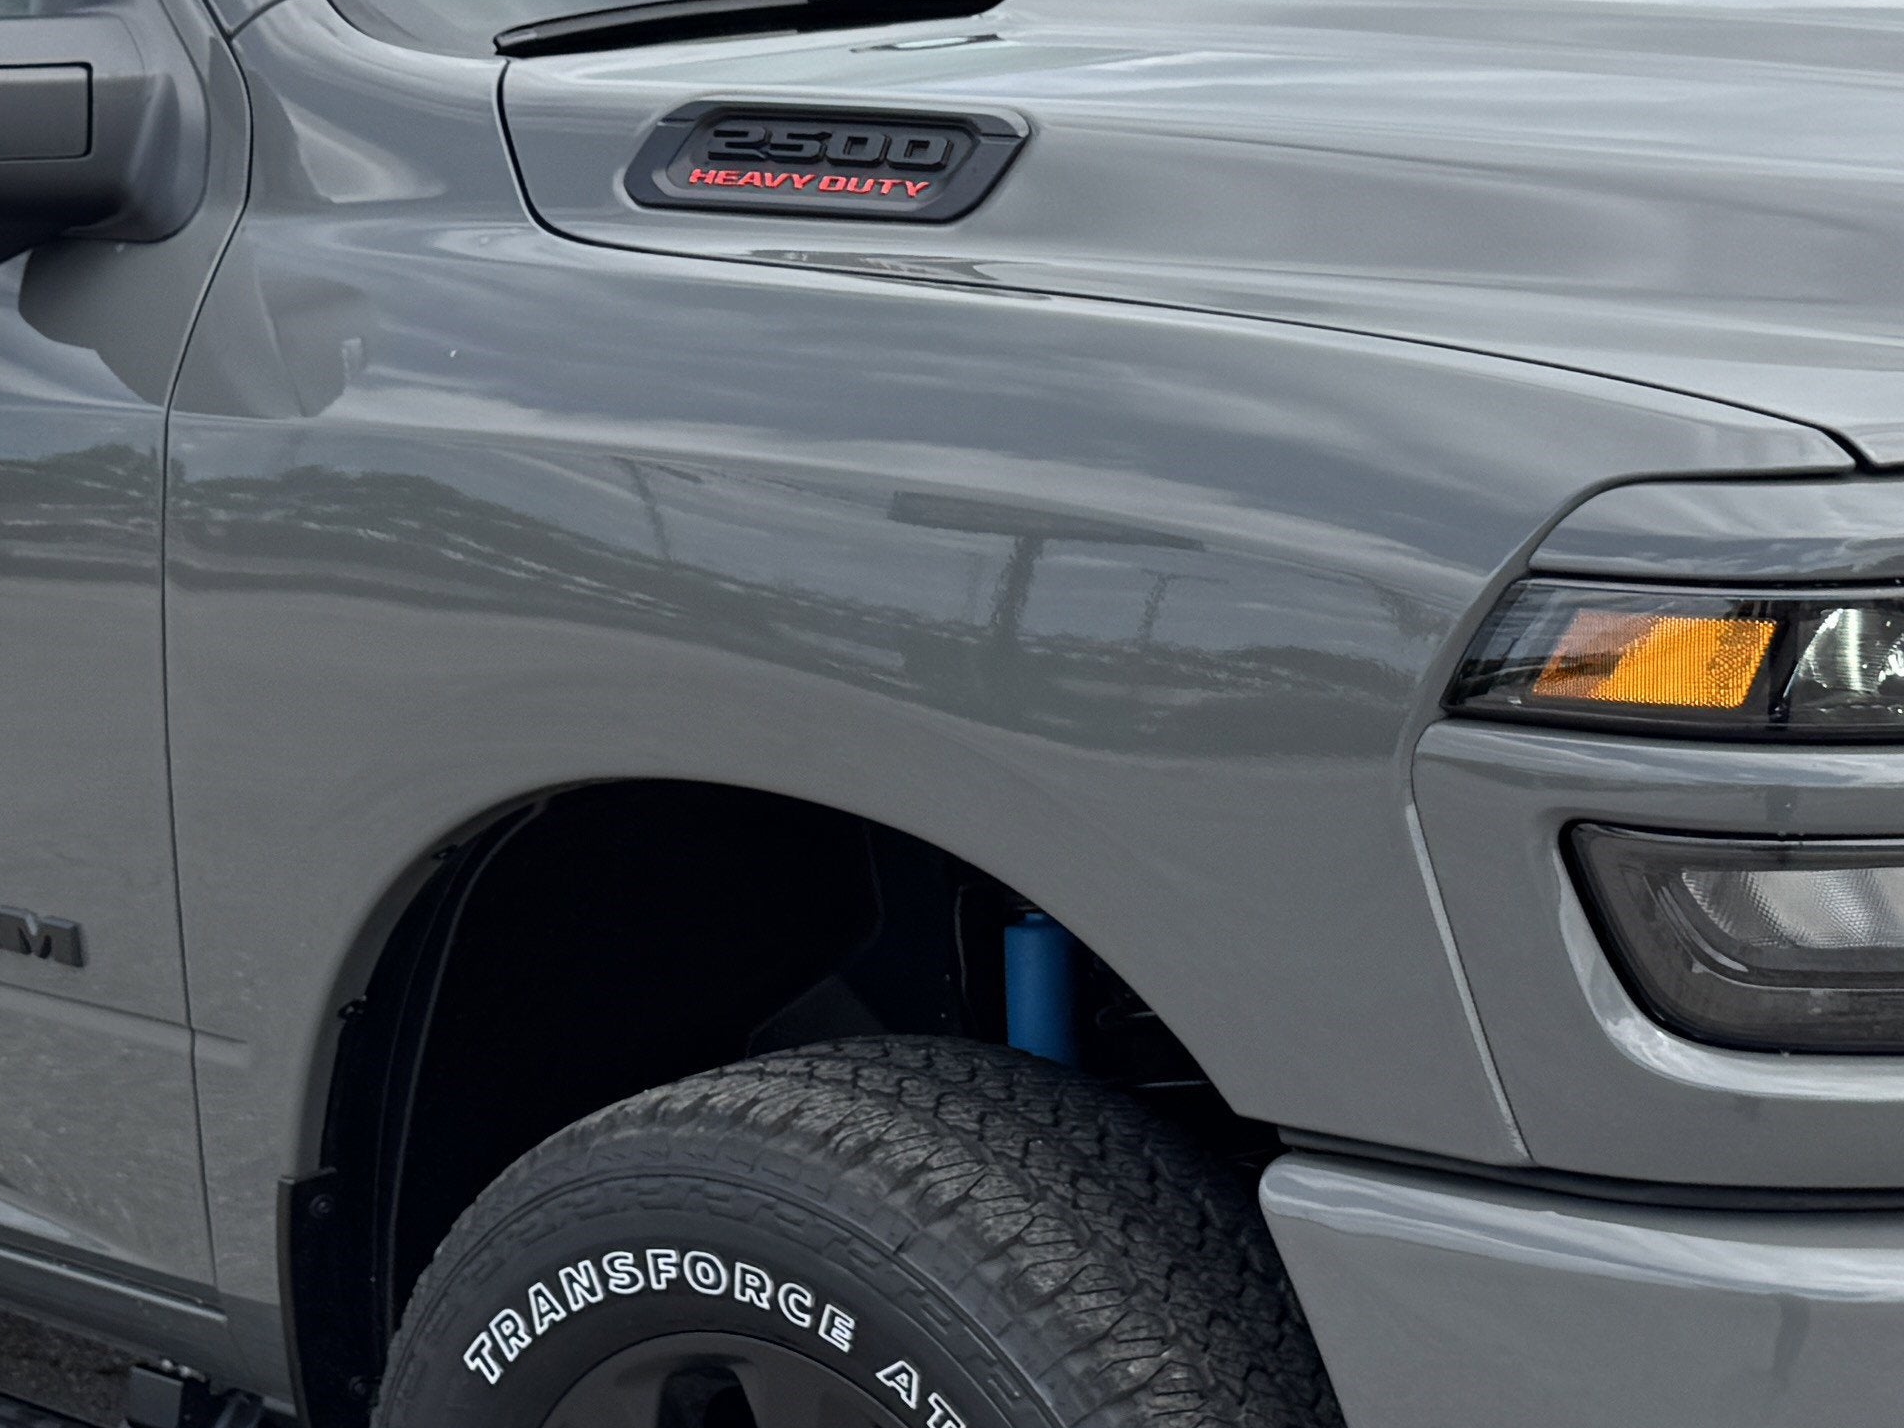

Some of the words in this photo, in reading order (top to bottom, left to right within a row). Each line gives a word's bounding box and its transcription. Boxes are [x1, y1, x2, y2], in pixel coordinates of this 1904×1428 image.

[708, 124, 954, 171] 2500
[688, 168, 816, 191] HEAVY
[818, 174, 931, 198] DUTY
[463, 1247, 858, 1386] TRANSFORCE
